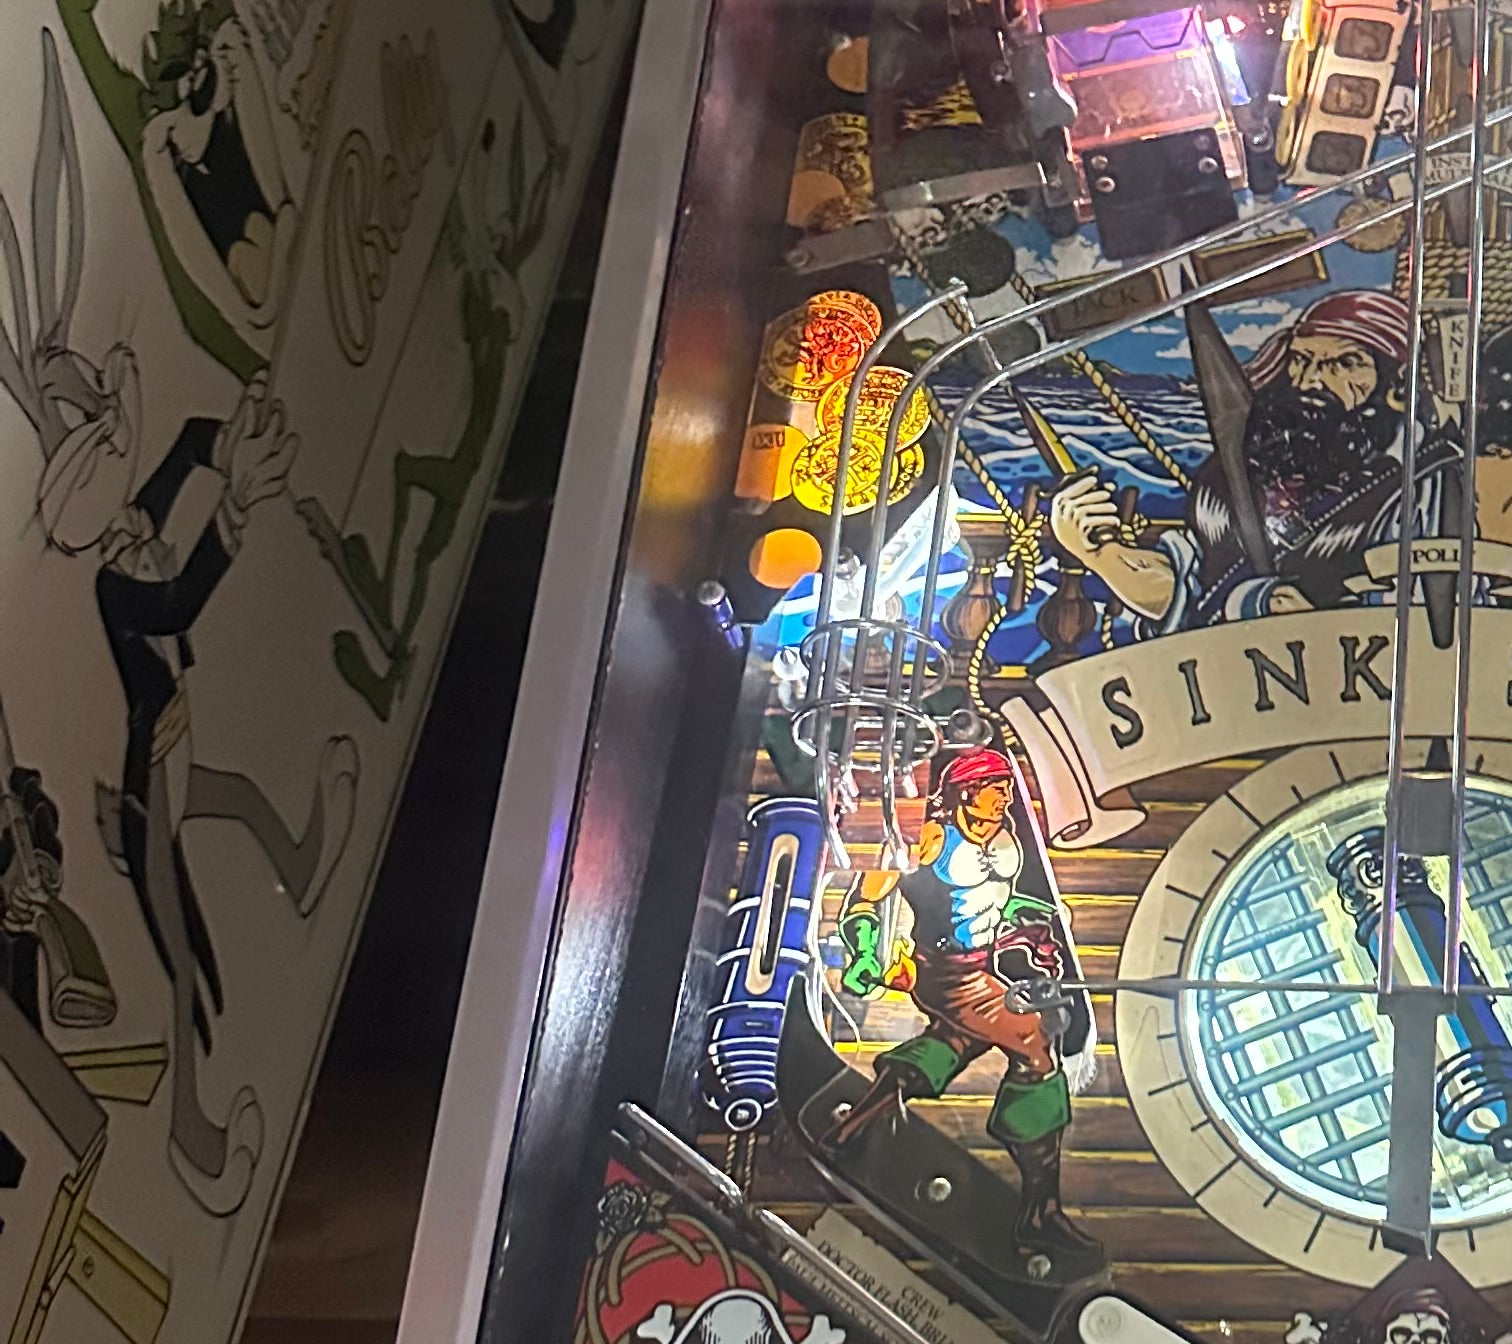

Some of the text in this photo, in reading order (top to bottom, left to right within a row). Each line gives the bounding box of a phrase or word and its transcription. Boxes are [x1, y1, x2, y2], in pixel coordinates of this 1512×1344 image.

[1450, 319, 1466, 397] KNIFE
[1105, 632, 1394, 750] SINK
[817, 1240, 878, 1290] DOCTOR
[900, 1285, 948, 1321] CREW
